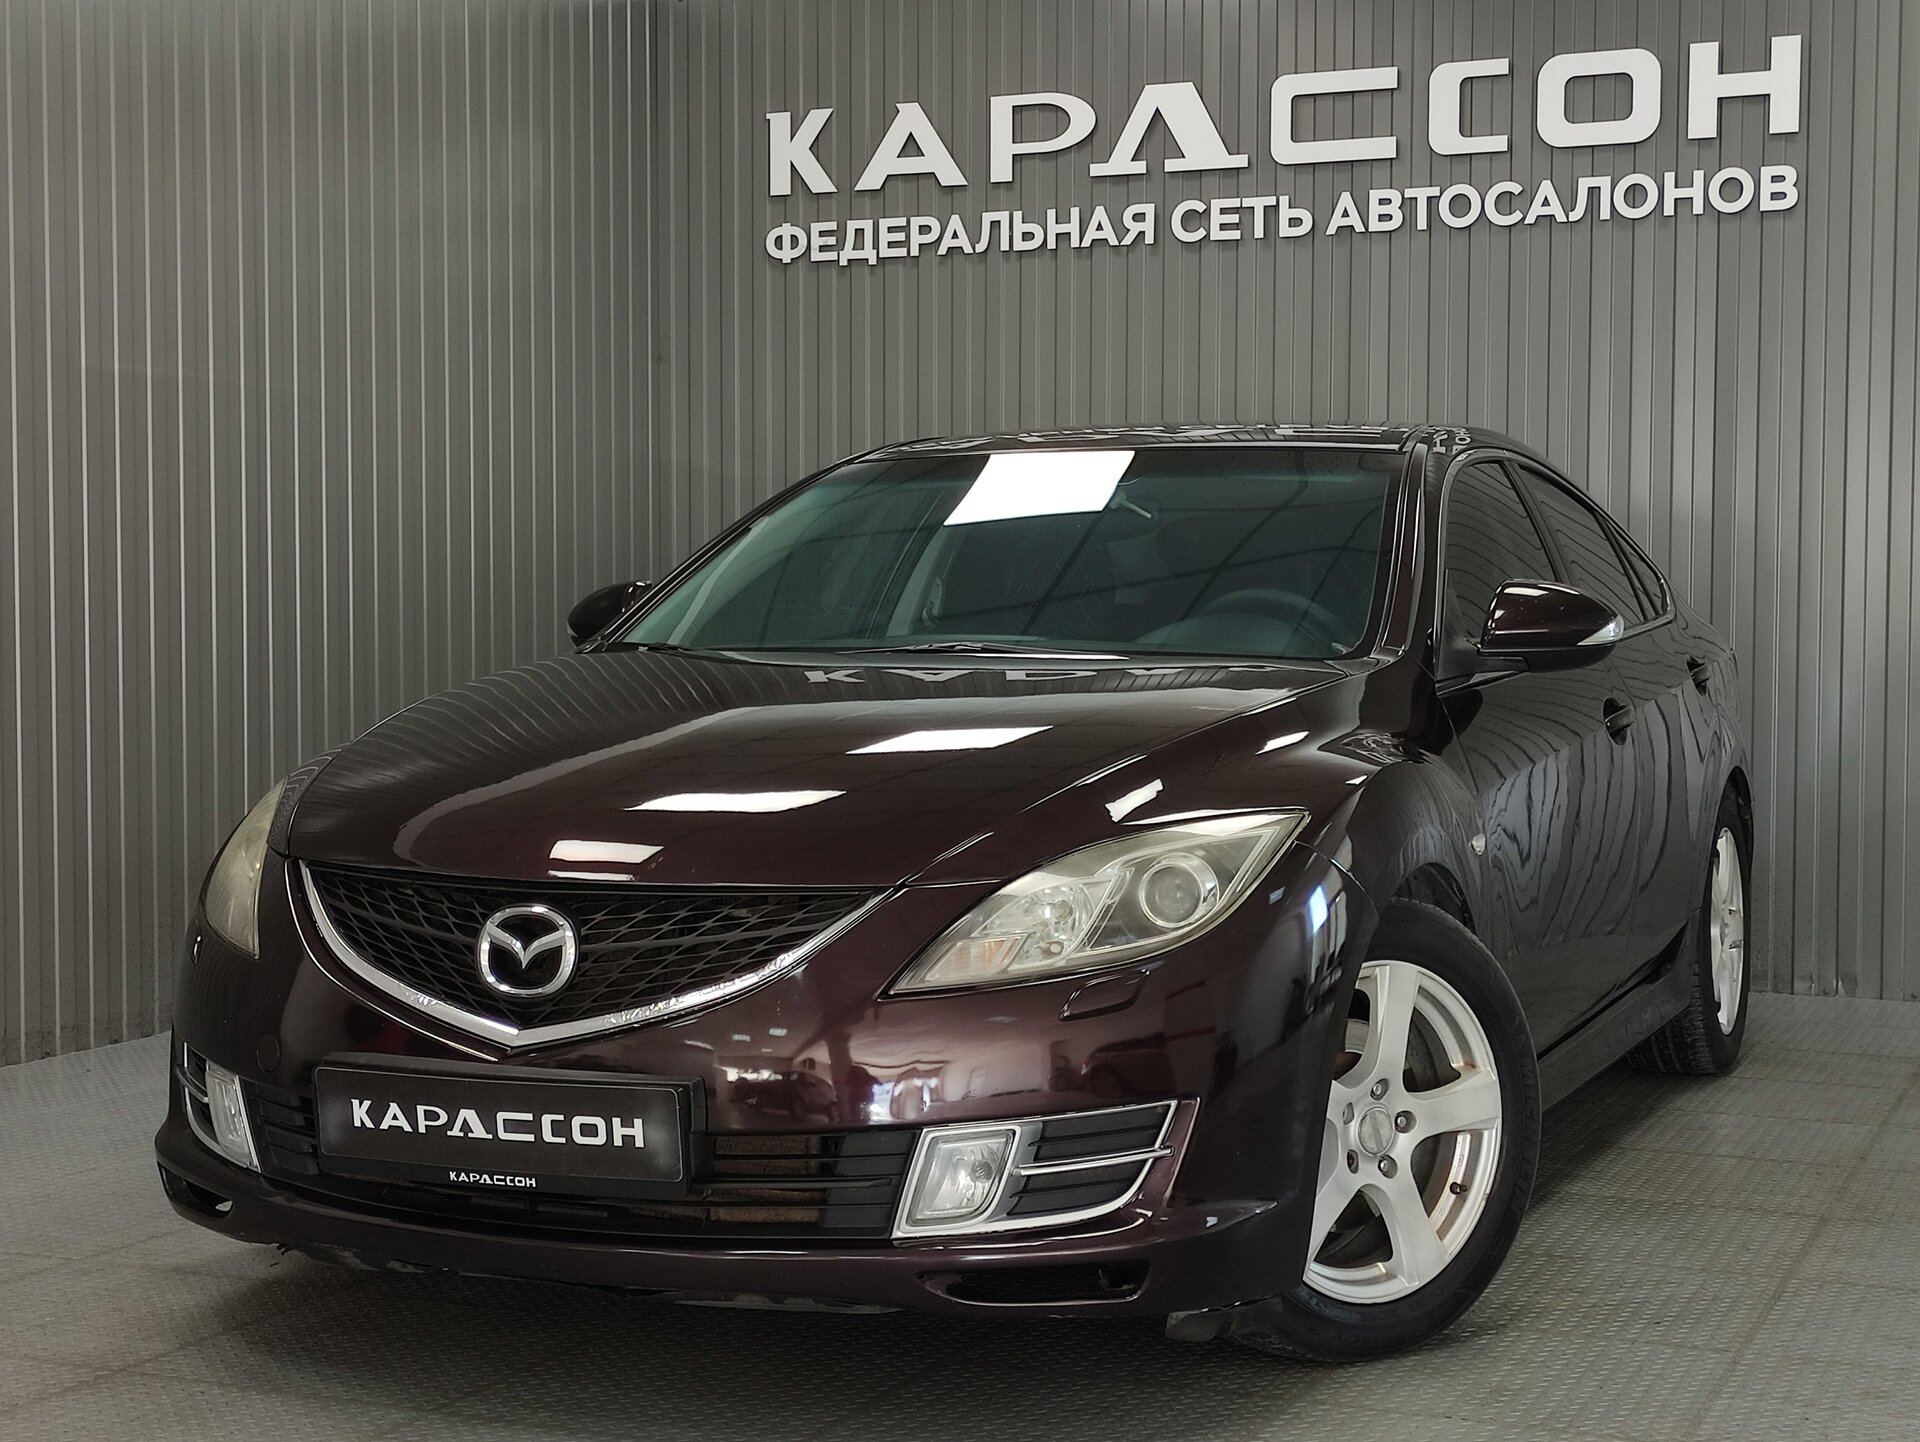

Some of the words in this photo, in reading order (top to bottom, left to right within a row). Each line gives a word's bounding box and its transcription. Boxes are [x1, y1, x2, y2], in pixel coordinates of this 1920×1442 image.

[765, 202, 1156, 267] ФЕДЕРАЛЬНАЯ
[1170, 194, 1314, 243] СЕТЬ
[1324, 164, 1799, 237] АВТОСАЛОНОВ
